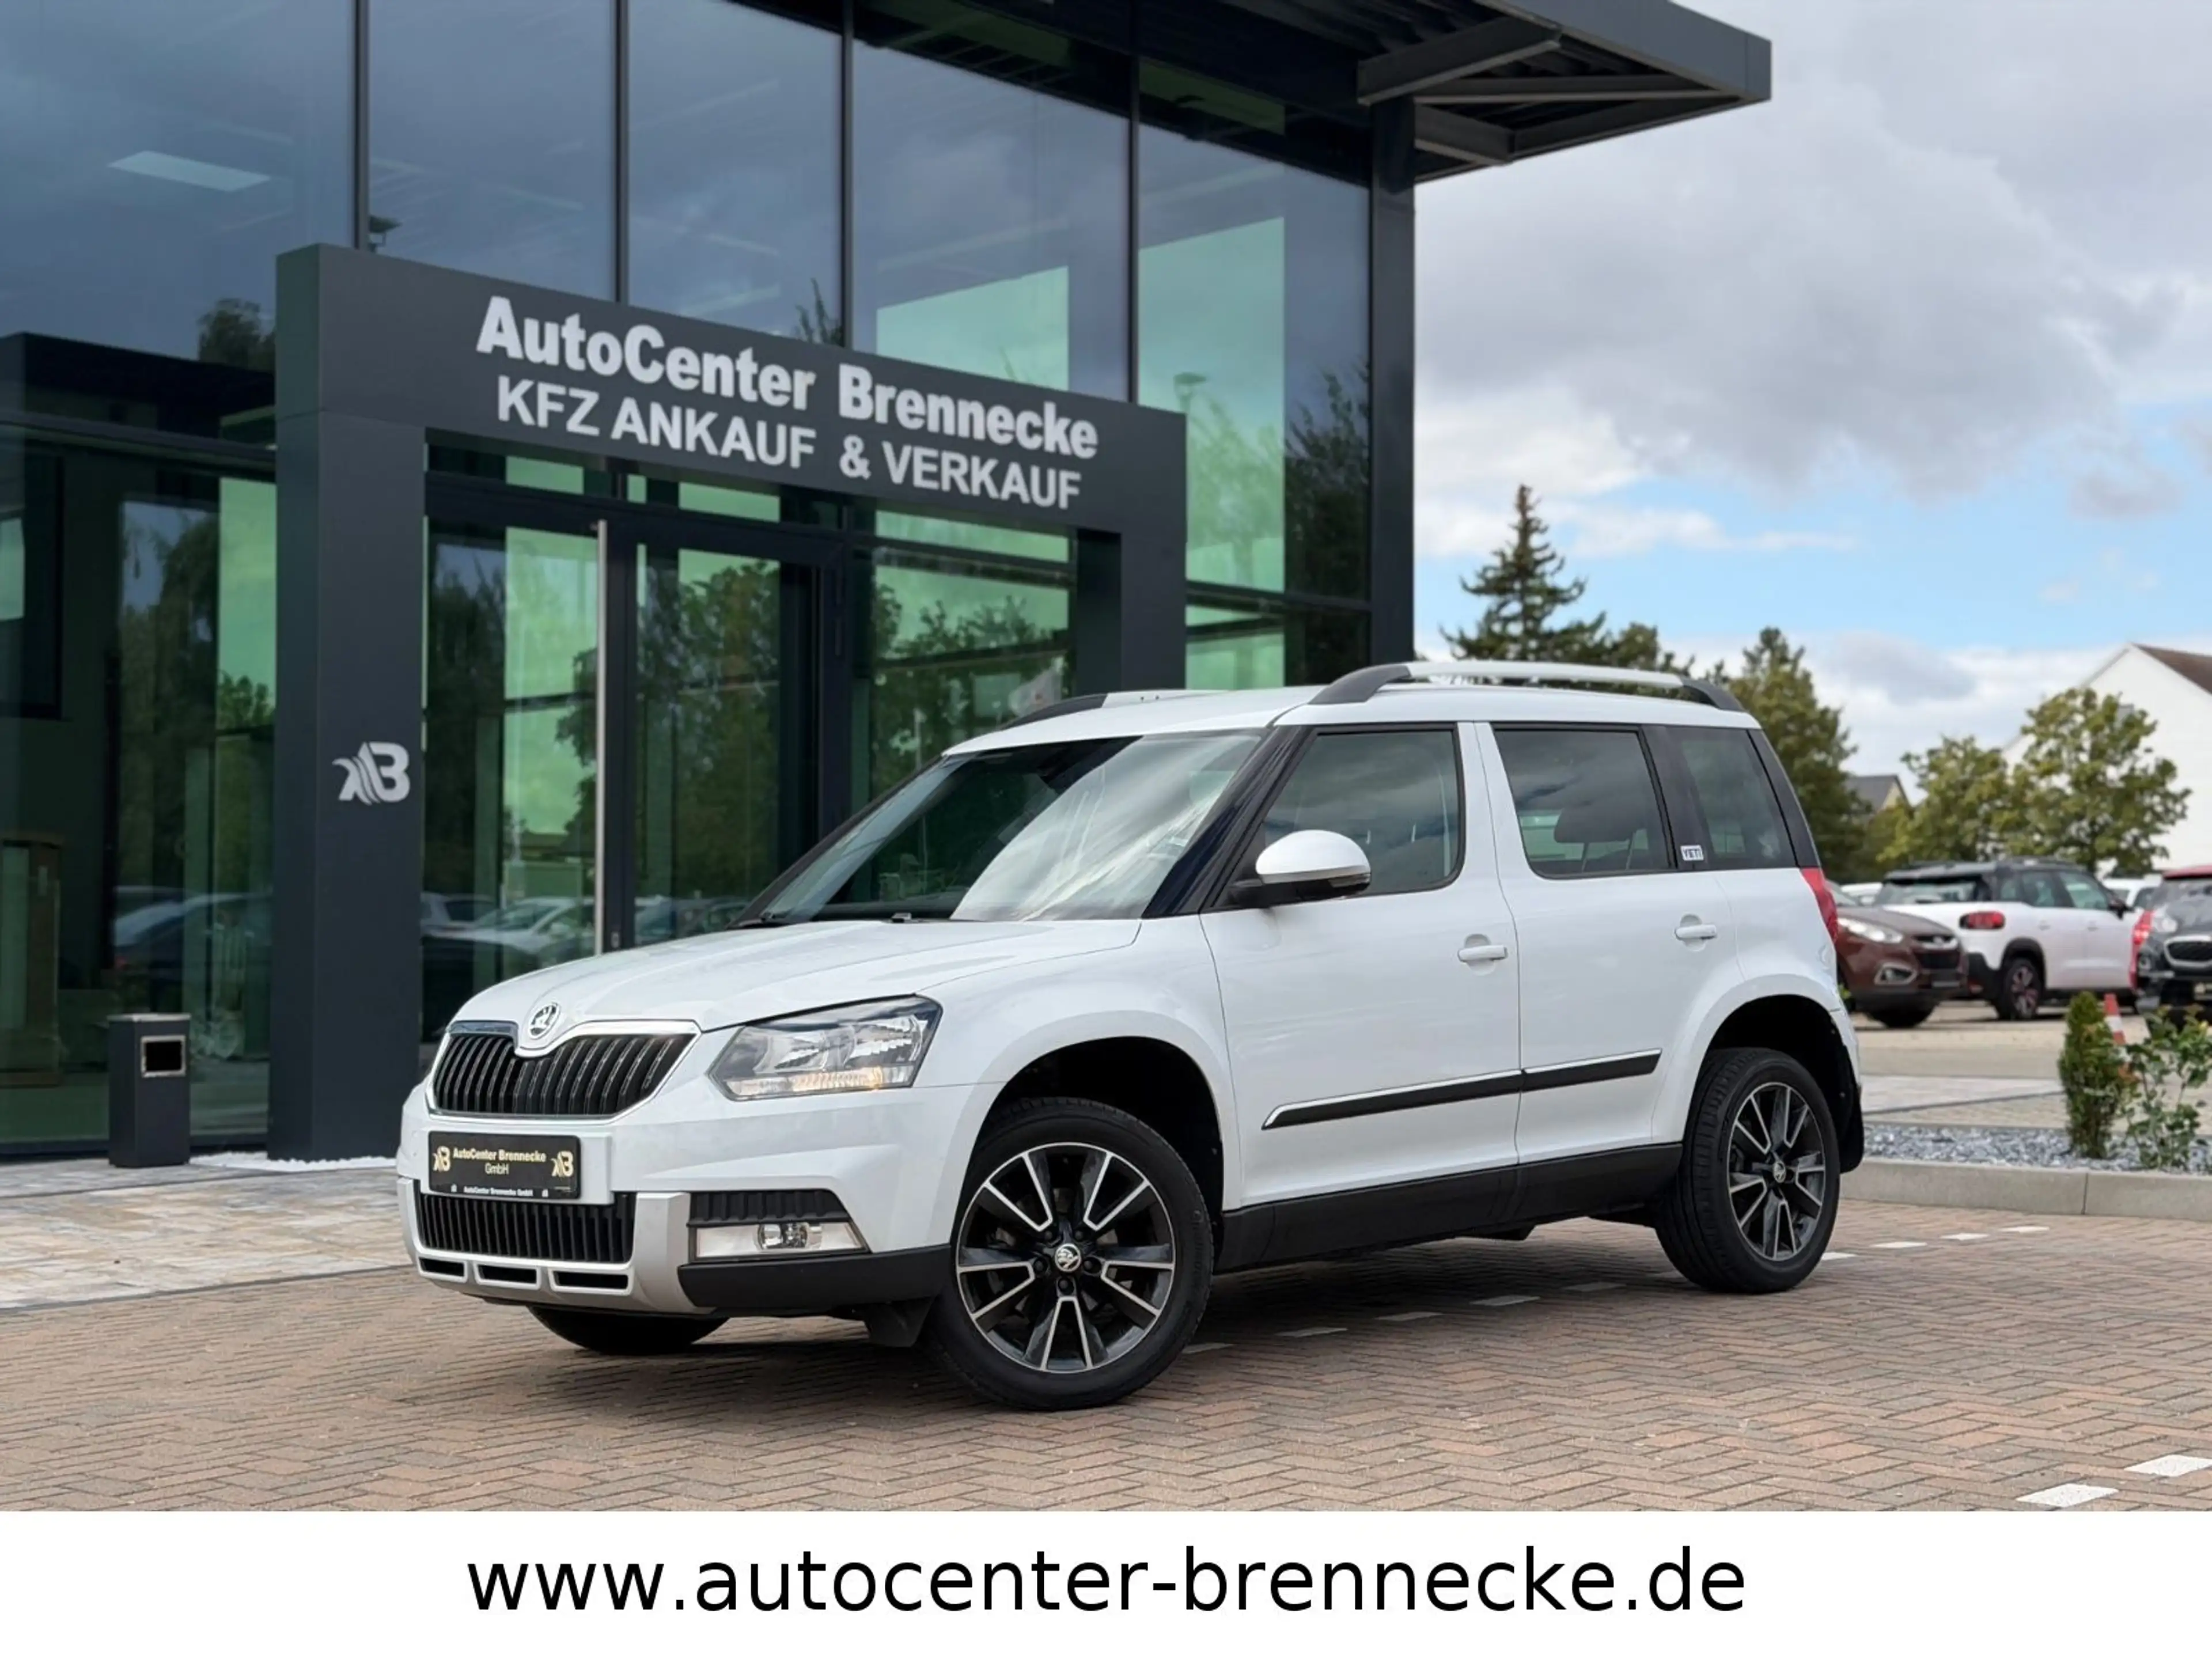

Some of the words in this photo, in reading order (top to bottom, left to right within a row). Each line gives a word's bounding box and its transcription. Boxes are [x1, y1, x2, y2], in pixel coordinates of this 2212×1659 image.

[476, 296, 816, 410] AutoCenter
[839, 363, 1098, 459] Brennecke
[498, 375, 600, 436] KFZ
[611, 397, 816, 468] ANKAUF
[839, 435, 870, 479] &
[882, 441, 1081, 509] VERKAUF
[1683, 849, 1702, 858] YETI
[453, 1148, 497, 1160] AutoCenter
[498, 1149, 547, 1162] Brennecke
[484, 1162, 509, 1175] GmbH
